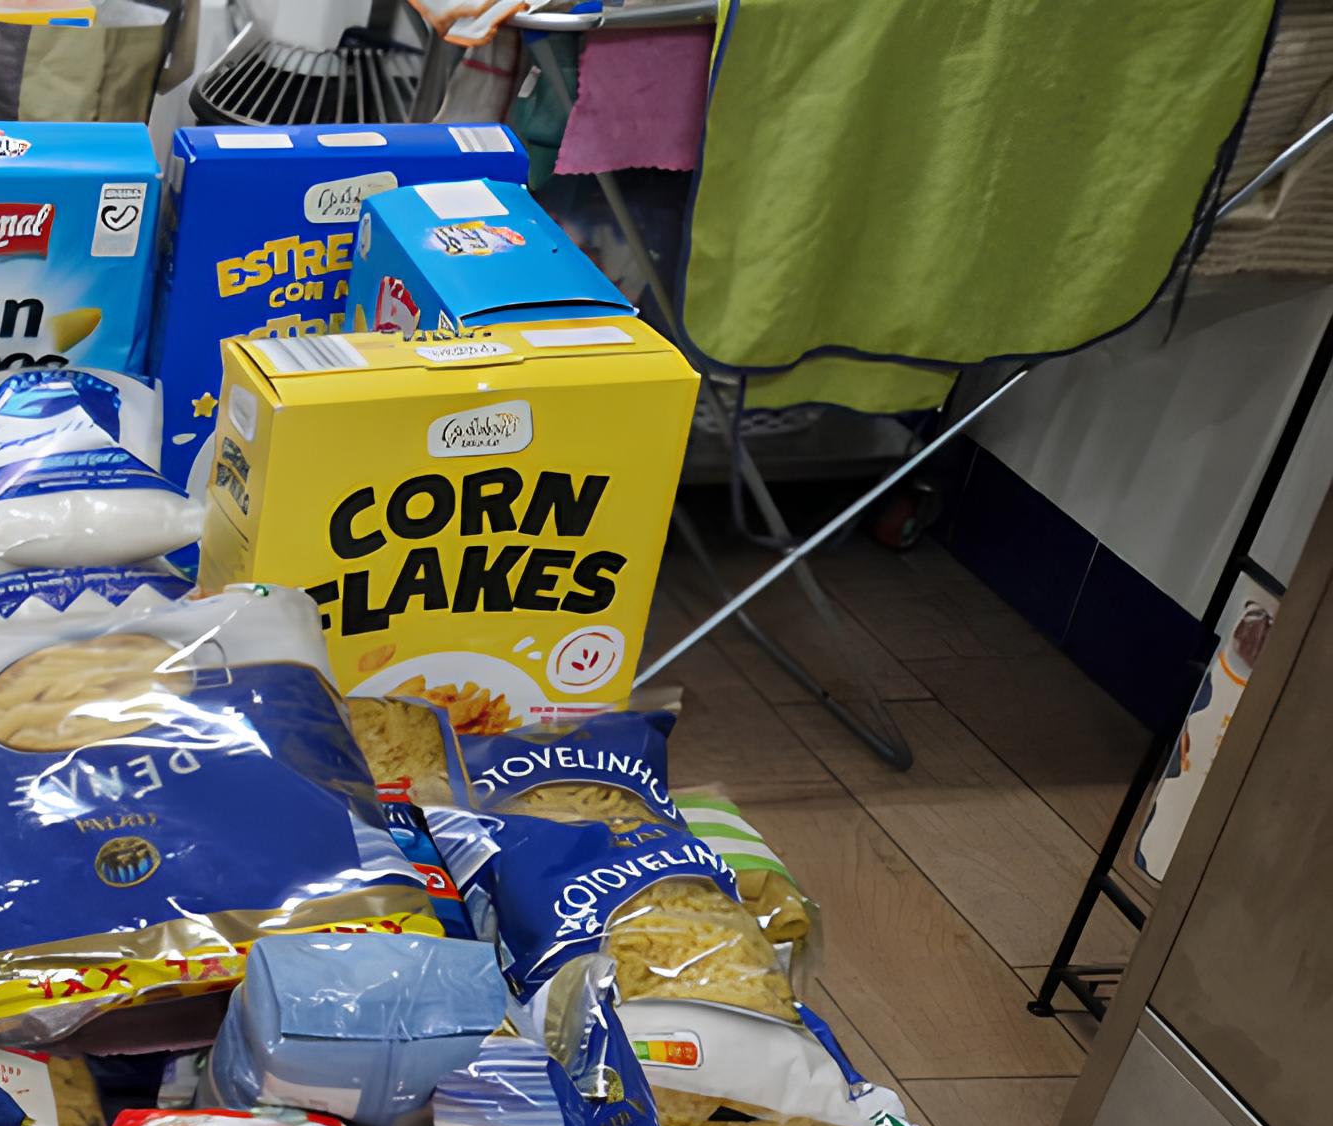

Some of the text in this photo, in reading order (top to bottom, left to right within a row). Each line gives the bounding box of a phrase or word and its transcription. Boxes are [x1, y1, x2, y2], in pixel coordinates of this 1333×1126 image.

[218, 233, 353, 298] ESTRE
[328, 467, 611, 560] CORN
[304, 544, 629, 638] FLAKES
